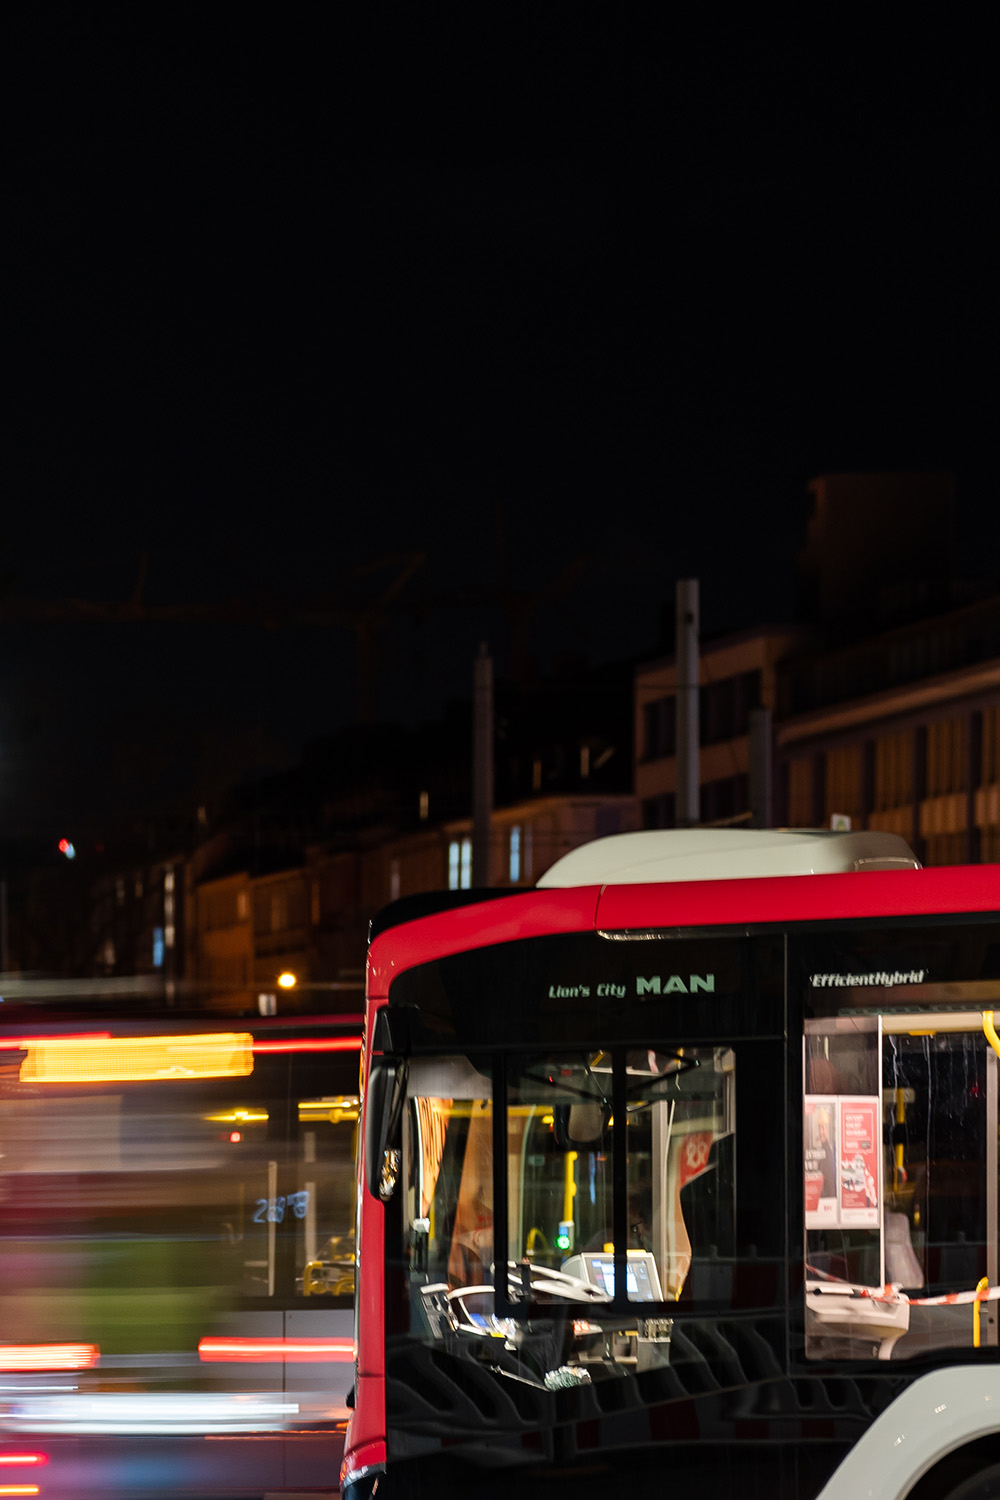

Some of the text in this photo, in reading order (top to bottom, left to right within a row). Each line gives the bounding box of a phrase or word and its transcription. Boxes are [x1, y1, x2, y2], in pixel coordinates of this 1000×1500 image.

[549, 973, 715, 998] Lion's City MAN
[812, 969, 924, 988] EfficientHybrid
